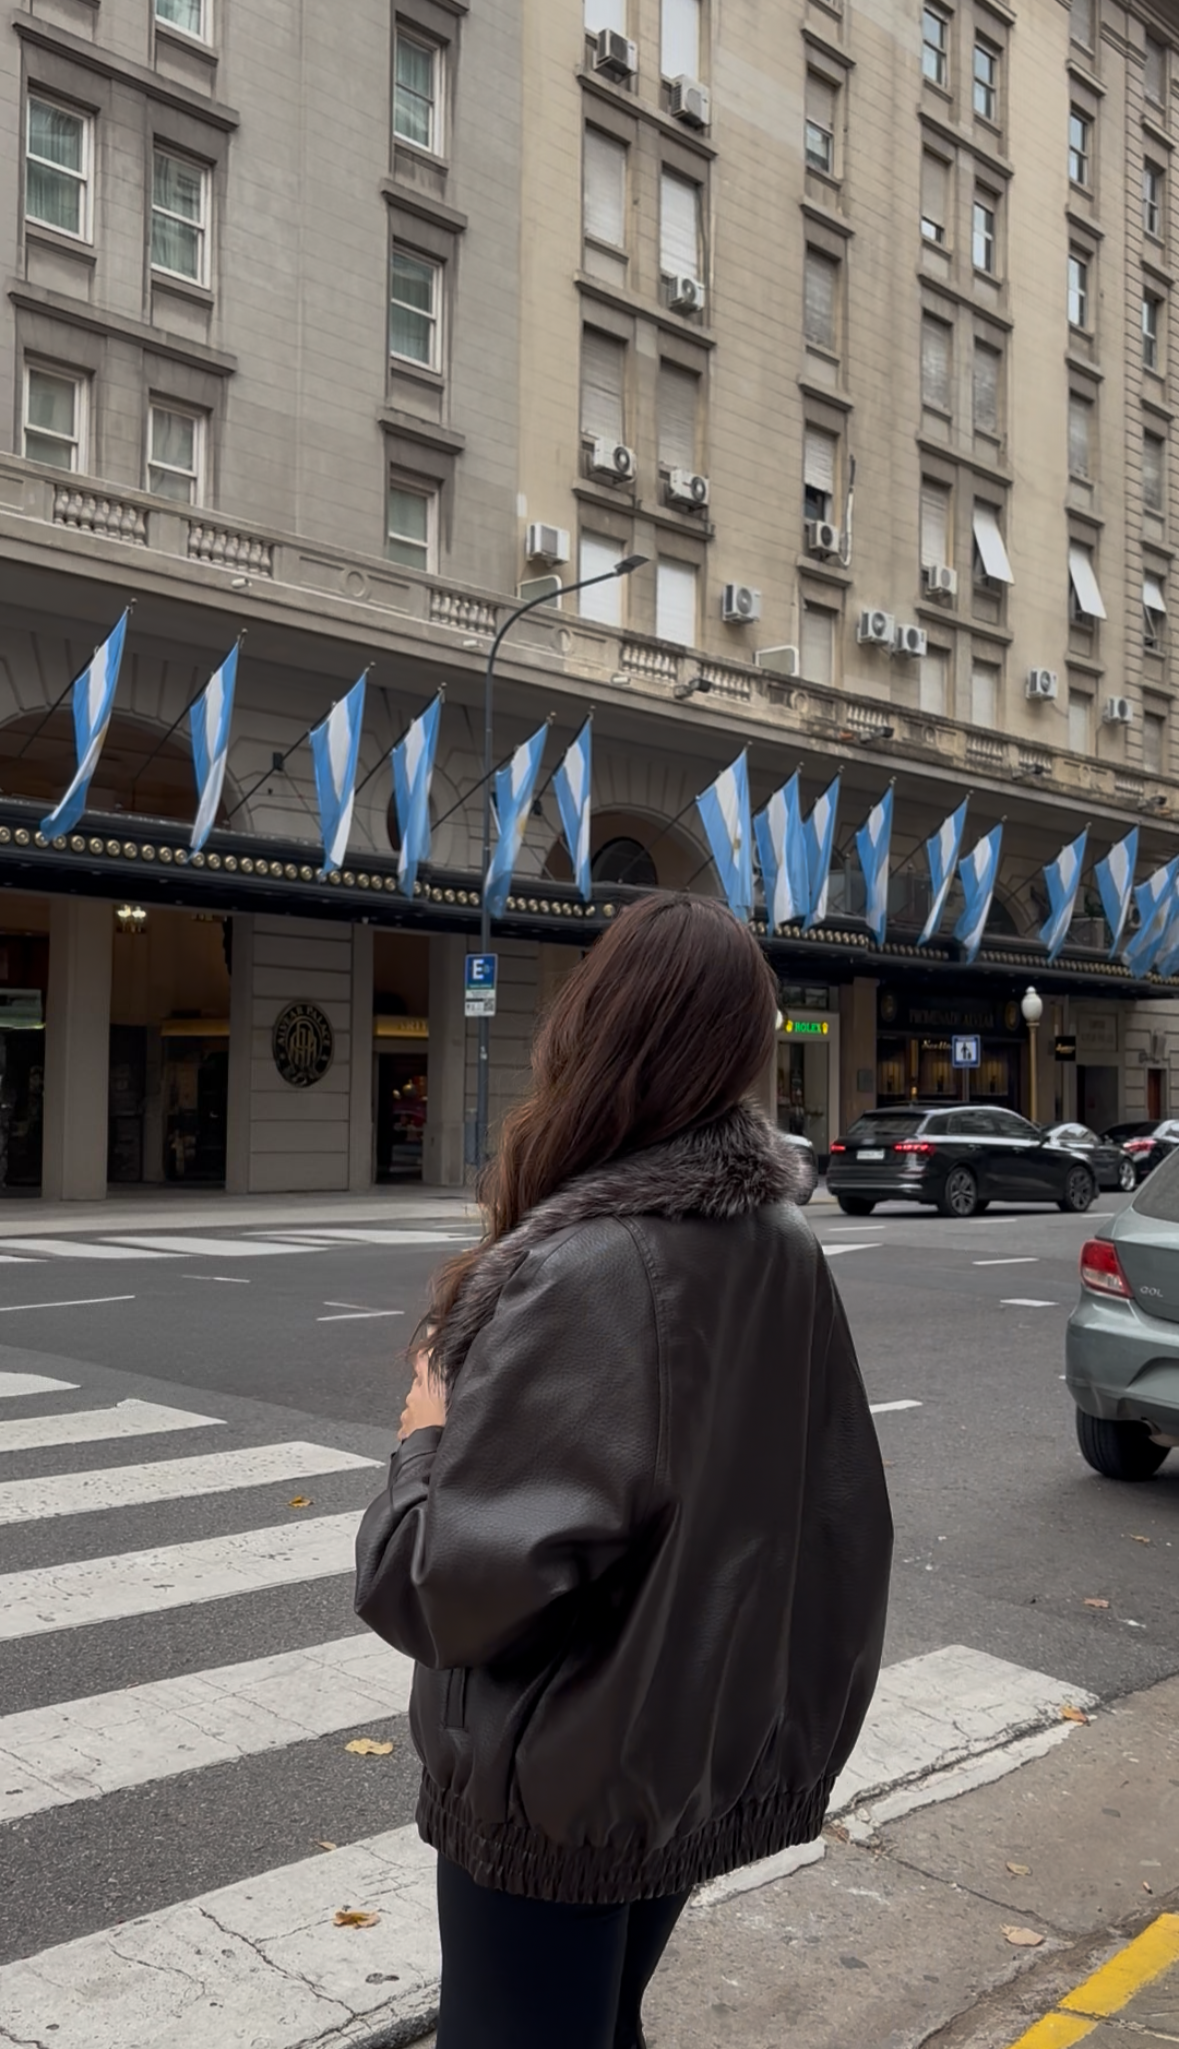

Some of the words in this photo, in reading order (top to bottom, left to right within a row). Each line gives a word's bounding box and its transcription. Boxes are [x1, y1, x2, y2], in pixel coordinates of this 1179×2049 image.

[472, 958, 484, 981] E
[277, 1005, 304, 1047] ALVEAR
[305, 1005, 332, 1047] PALACE
[795, 1022, 821, 1034] ROLEX
[1140, 1285, 1164, 1298] GOL
